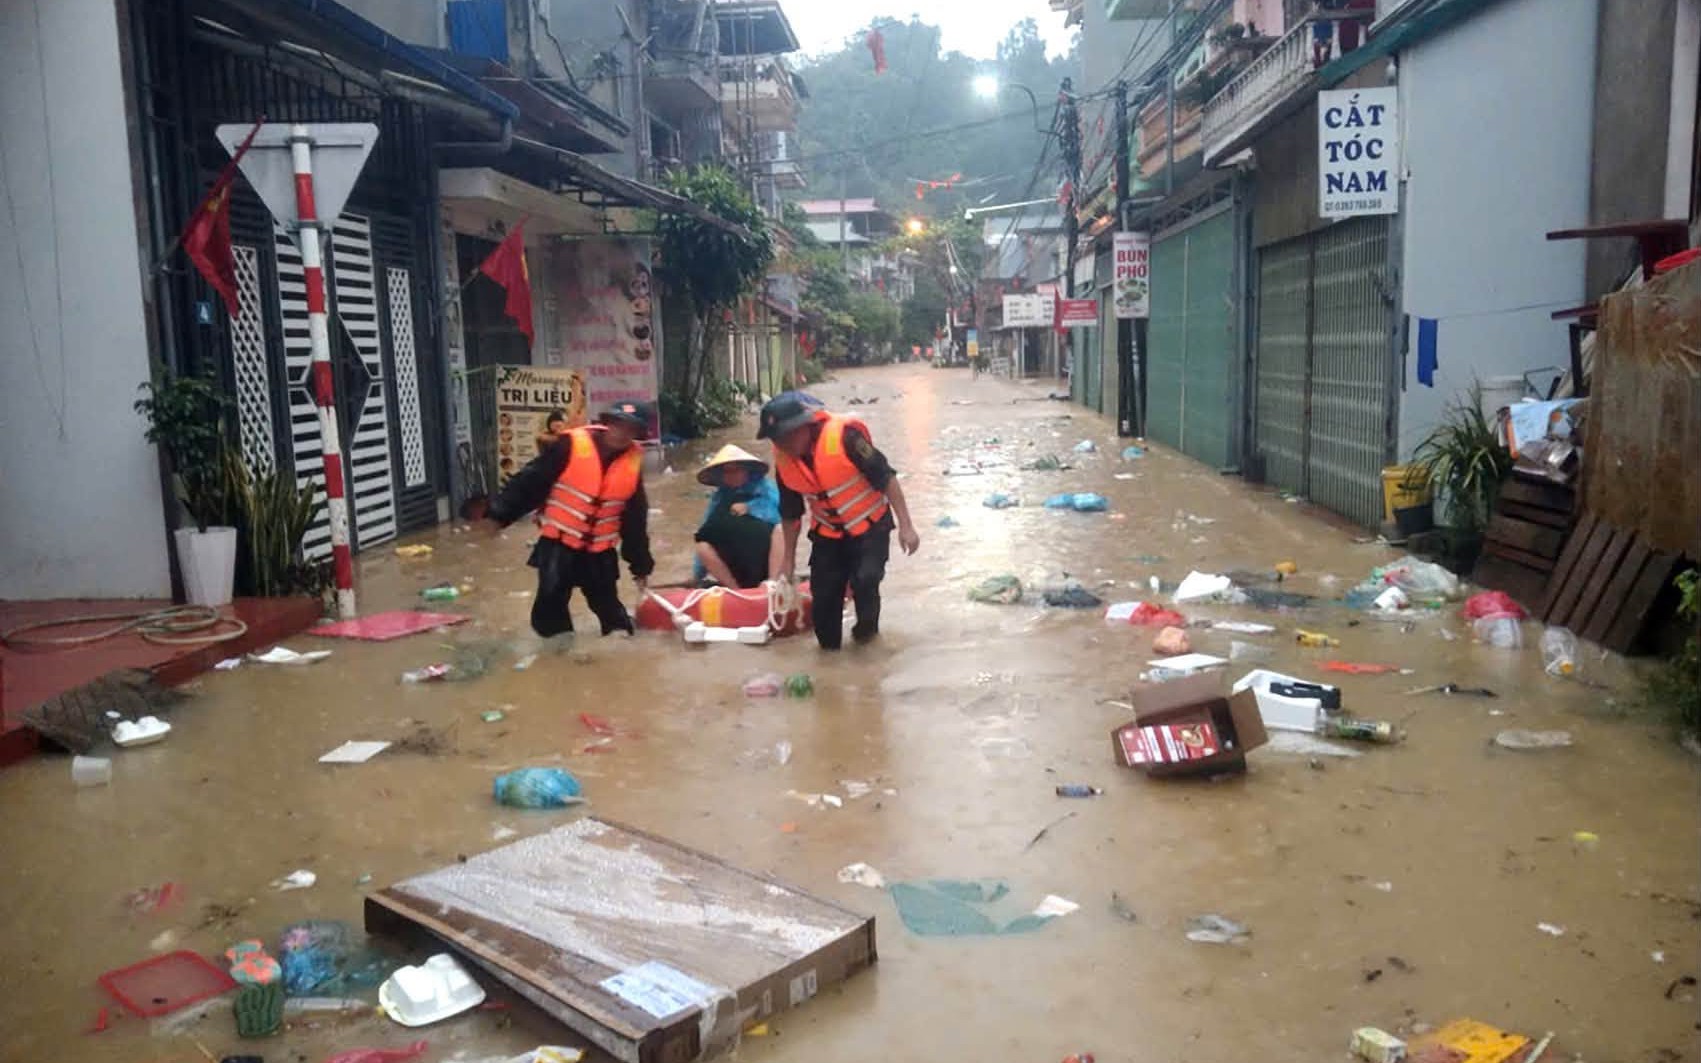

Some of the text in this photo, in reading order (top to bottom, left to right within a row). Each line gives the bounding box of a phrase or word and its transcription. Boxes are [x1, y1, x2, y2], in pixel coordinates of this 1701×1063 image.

[1325, 93, 1385, 129] CẮT
[1325, 133, 1384, 163] TÓC
[1325, 170, 1388, 195] NAM
[501, 389, 529, 405] TRỊ
[534, 387, 572, 407] LIỆU
